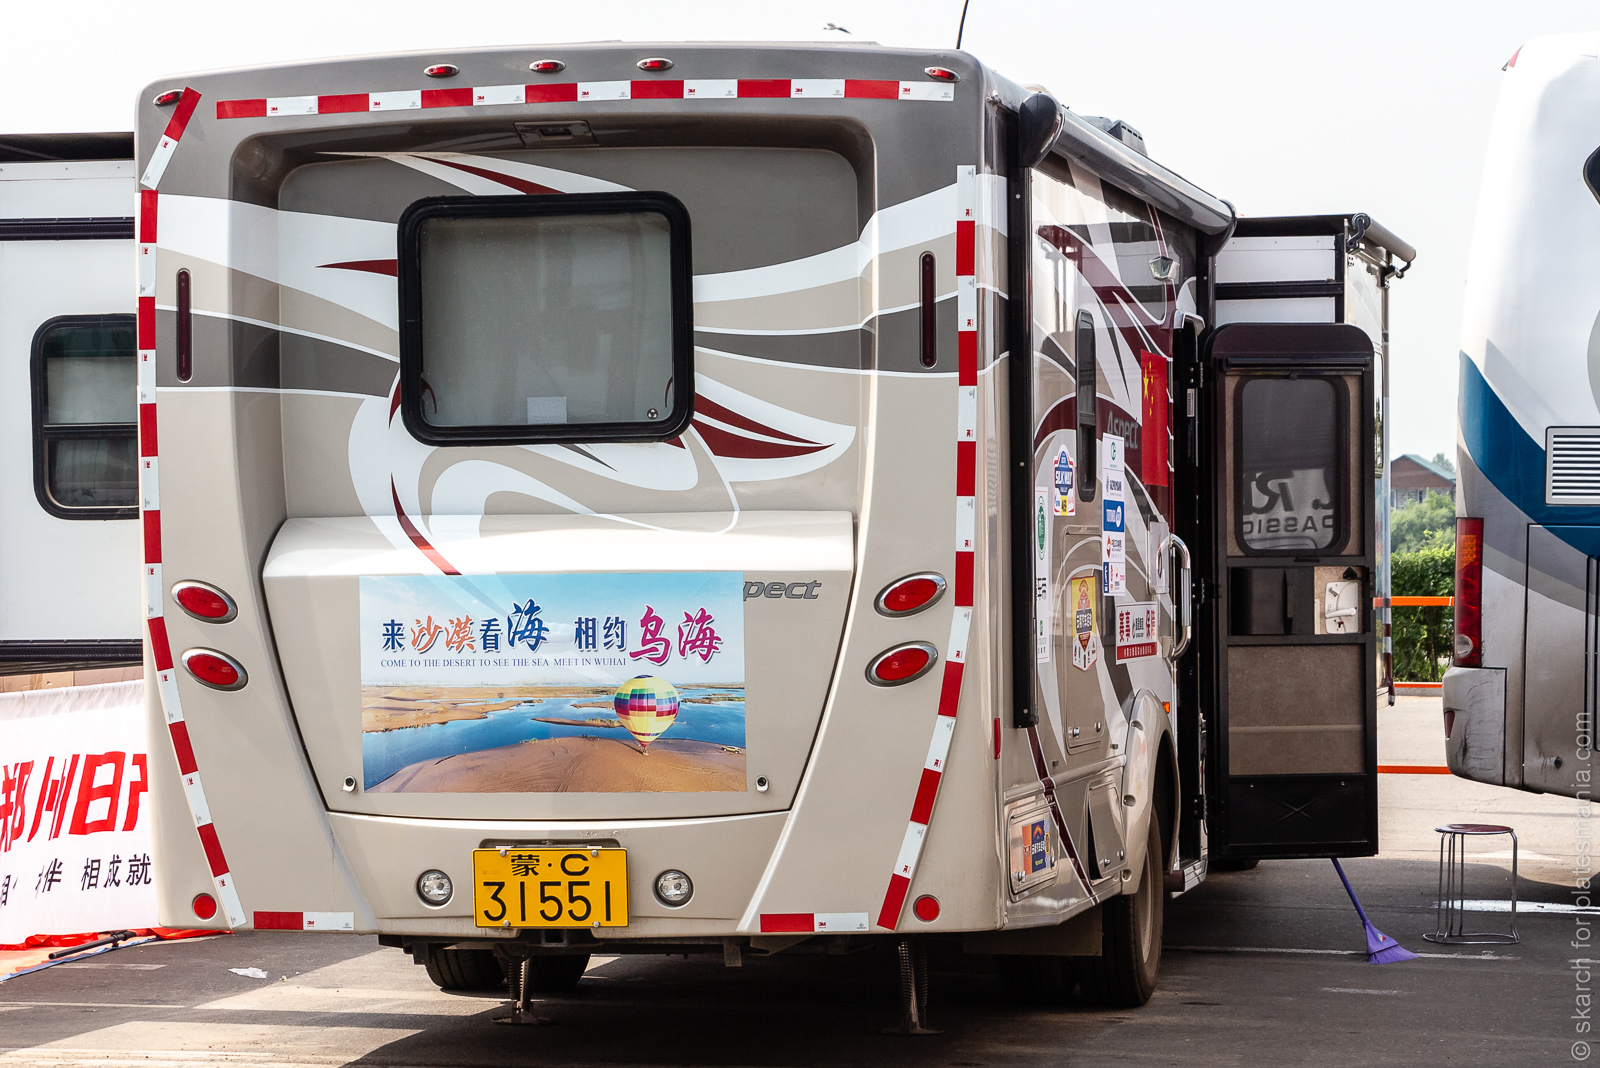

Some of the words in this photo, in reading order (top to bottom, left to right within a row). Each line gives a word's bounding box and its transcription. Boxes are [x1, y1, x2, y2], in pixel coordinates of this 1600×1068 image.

[743, 580, 822, 601] pect
[382, 598, 550, 653] 来沙漠看海
[574, 604, 724, 665] 相约乌海
[381, 659, 406, 667] COME
[409, 659, 421, 667] TO
[423, 659, 440, 667] THE
[443, 659, 476, 667] DESERT
[480, 659, 491, 667] TO
[493, 658, 510, 667] SEE
[512, 658, 530, 667] THE
[532, 658, 549, 667] SEA
[81, 853, 152, 891] 相成就
[483, 880, 612, 922] 31551
